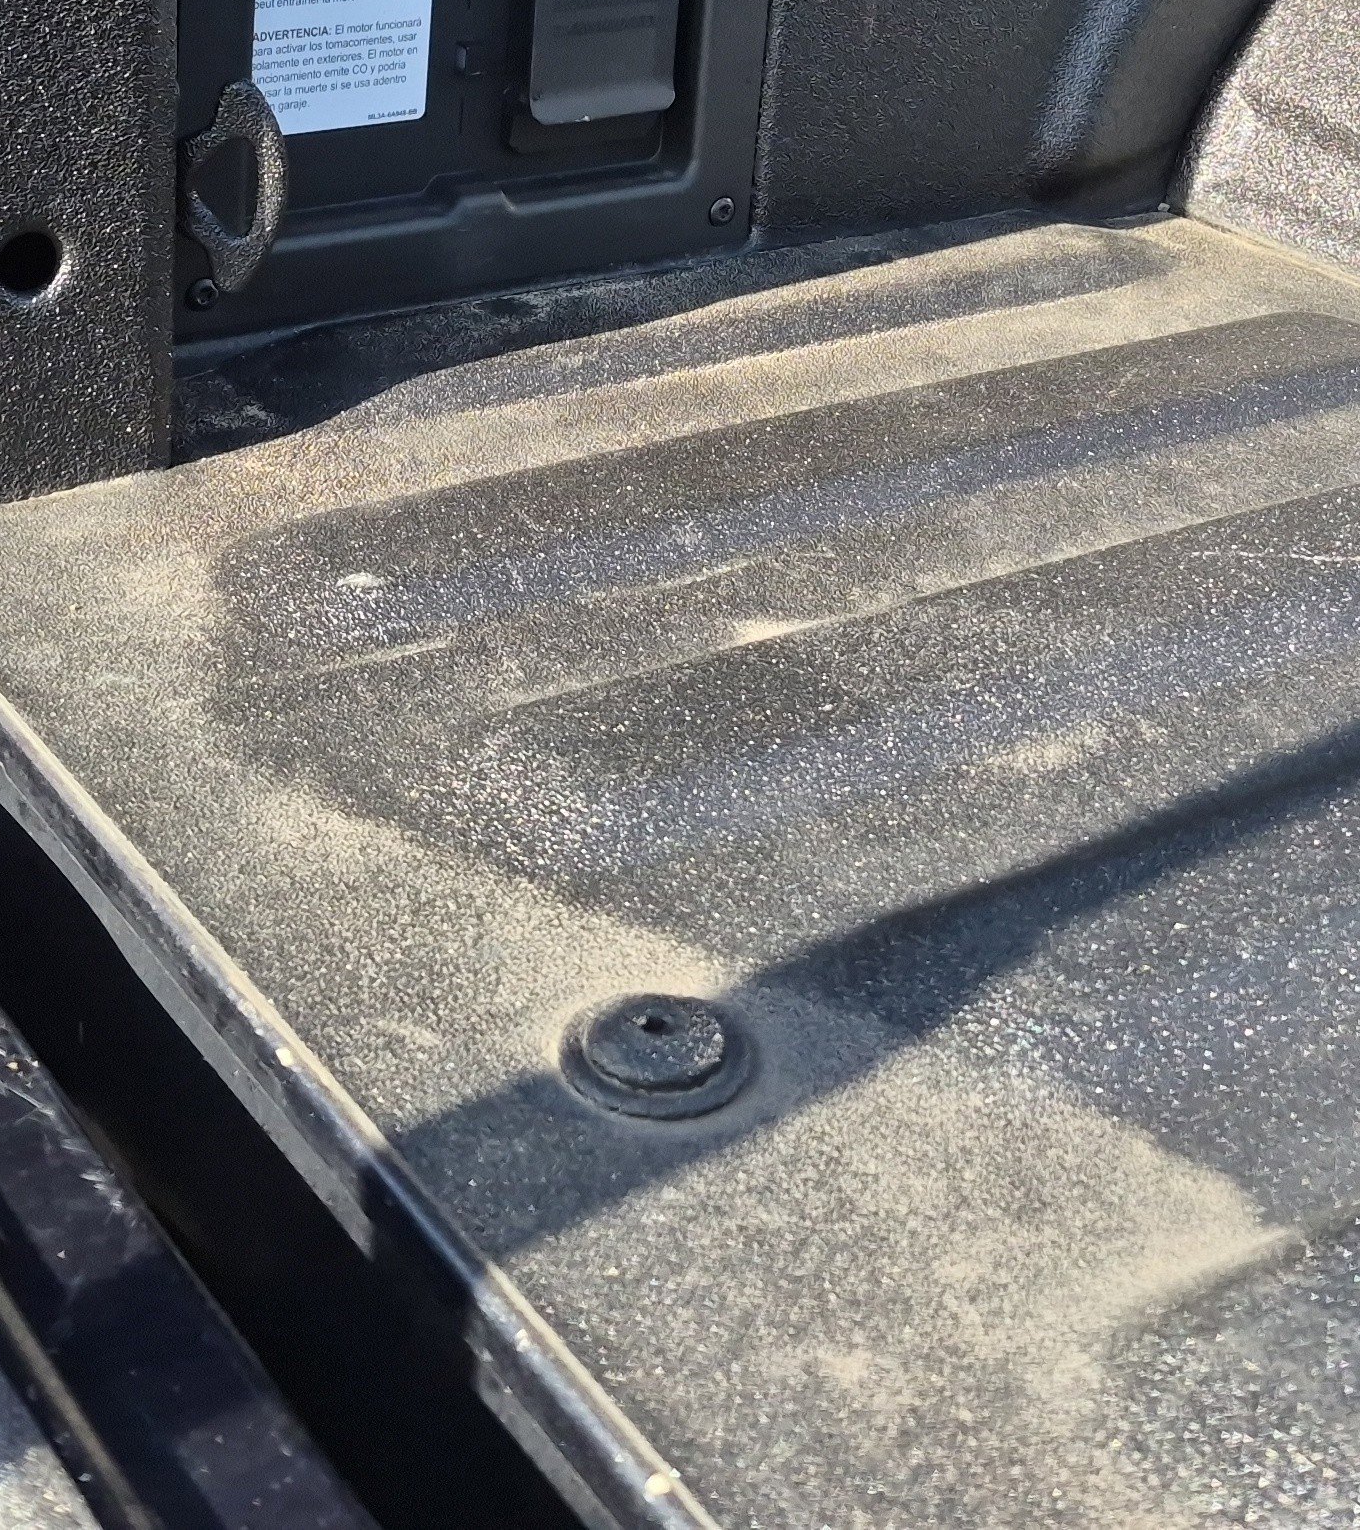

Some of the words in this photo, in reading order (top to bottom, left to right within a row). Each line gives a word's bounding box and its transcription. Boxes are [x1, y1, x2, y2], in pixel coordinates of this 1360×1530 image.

[253, 26, 332, 42] ADVERTENCIA:
[335, 24, 345, 35] El
[346, 23, 374, 34] motor
[376, 18, 422, 30] funcionará
[276, 44, 307, 54] activar
[310, 41, 322, 51] los
[398, 32, 417, 43] usar
[252, 58, 300, 71] solamente
[302, 57, 314, 66] en
[316, 52, 364, 64] exteriores.
[368, 48, 376, 60] El
[379, 48, 404, 58] motor
[406, 46, 418, 56] en
[324, 66, 350, 78] emite
[352, 64, 368, 74] CO
[370, 65, 376, 75] y
[284, 86, 292, 96] la
[295, 84, 328, 94] muerte
[330, 81, 338, 91] si
[340, 81, 352, 90] se
[354, 79, 370, 88] usa
[372, 74, 406, 86] adentro
[278, 100, 310, 113] garaje.
